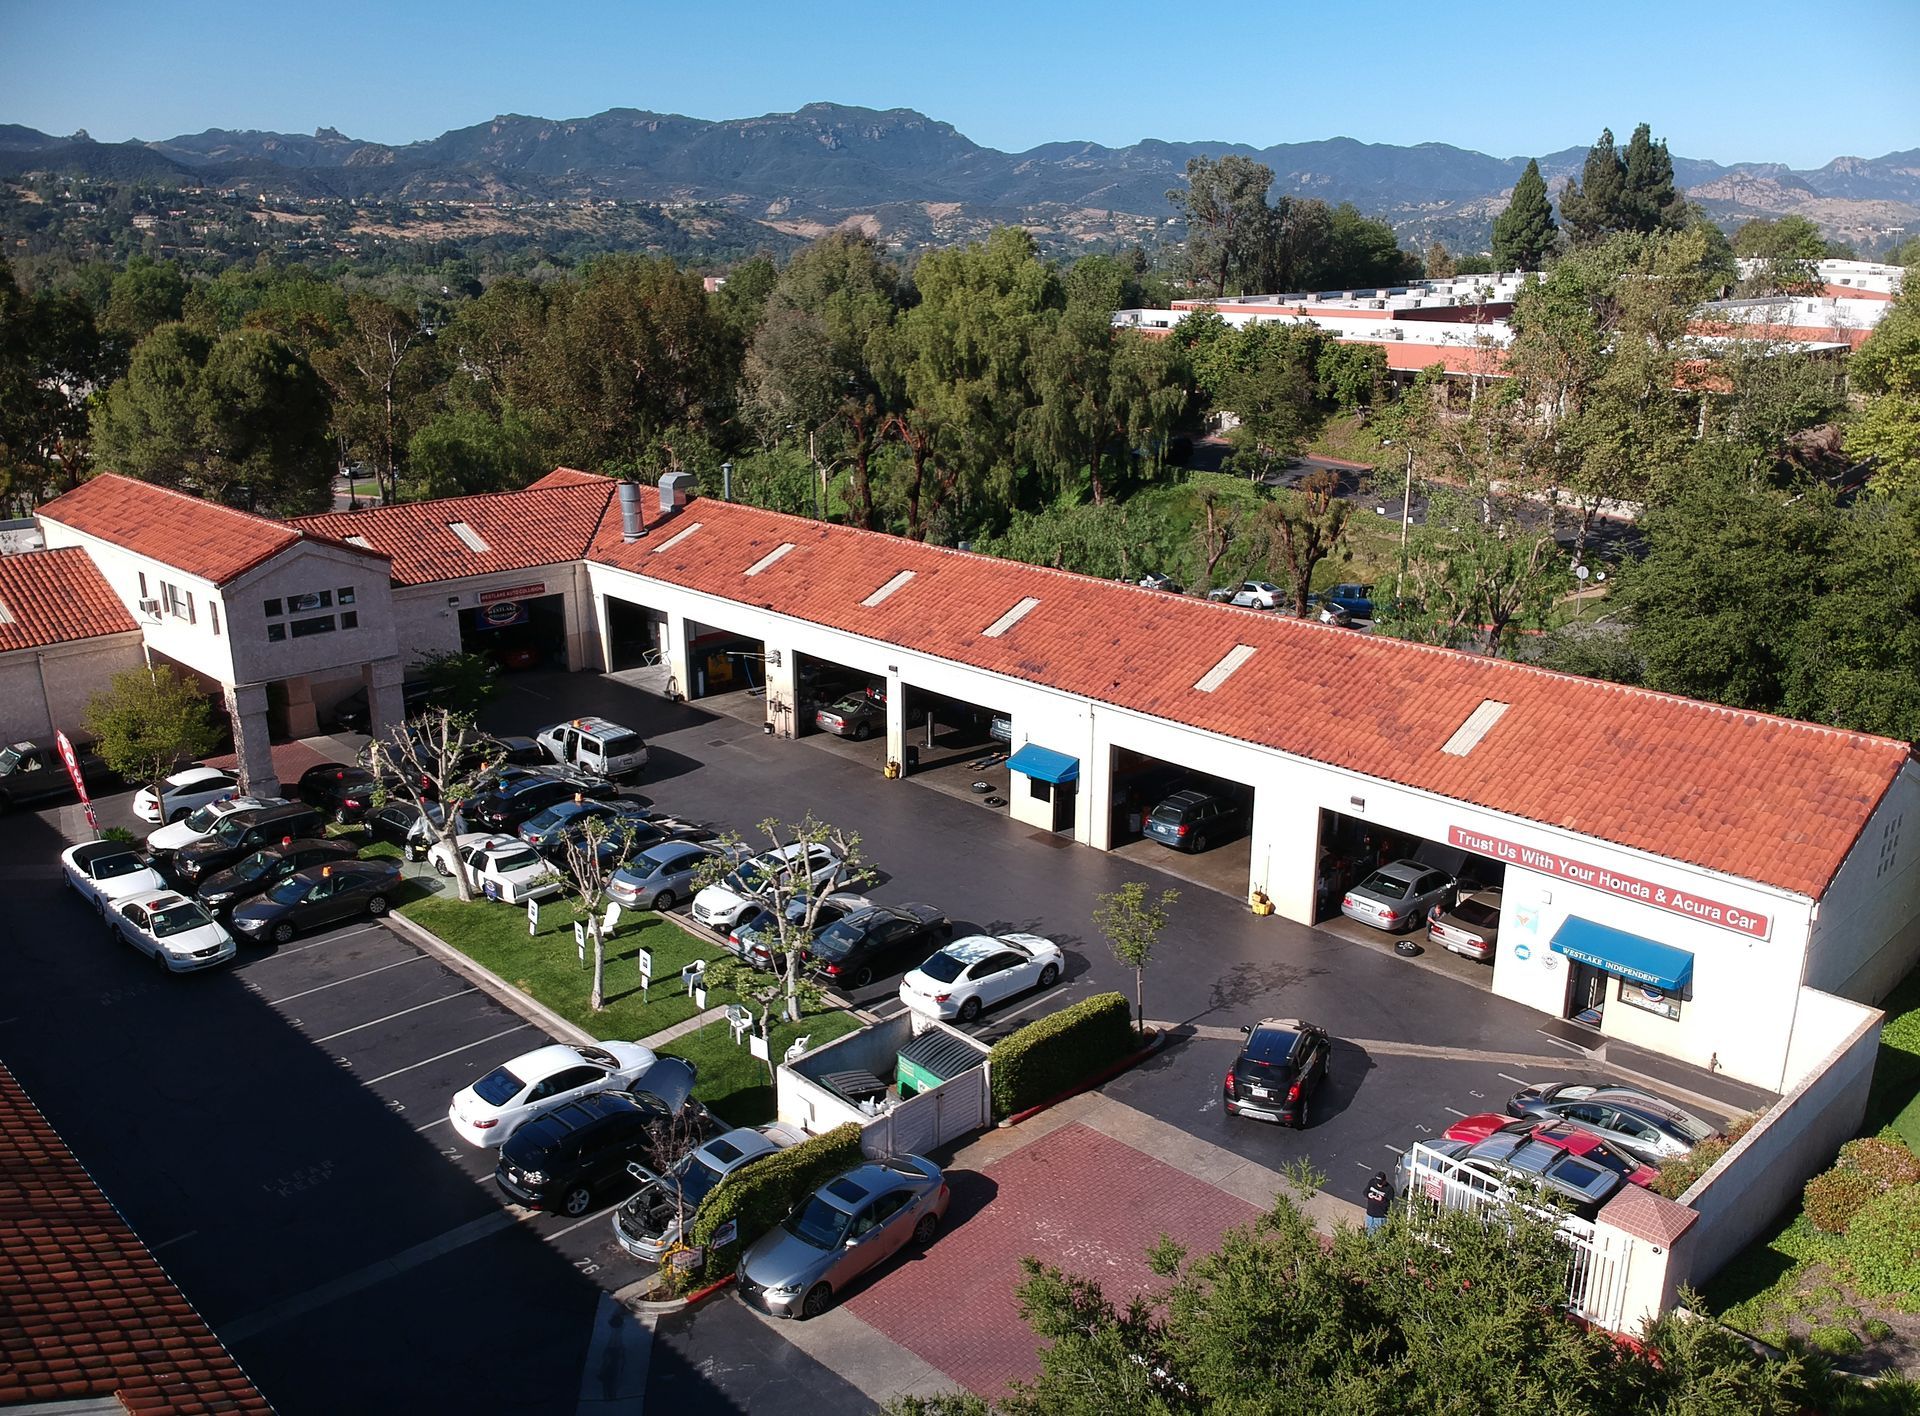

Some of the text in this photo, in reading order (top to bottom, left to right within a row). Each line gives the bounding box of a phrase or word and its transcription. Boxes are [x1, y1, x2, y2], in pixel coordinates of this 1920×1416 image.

[1457, 830, 1757, 930] Trust Us With Your Honda & Acura Car
[1562, 946, 1603, 966] WESTLAKE
[1605, 961, 1660, 983] INDEPENDENT
[1469, 1090, 1484, 1098] 3
[1415, 1124, 1432, 1133] 2
[440, 1147, 463, 1162] 24
[572, 1257, 600, 1275] 26
